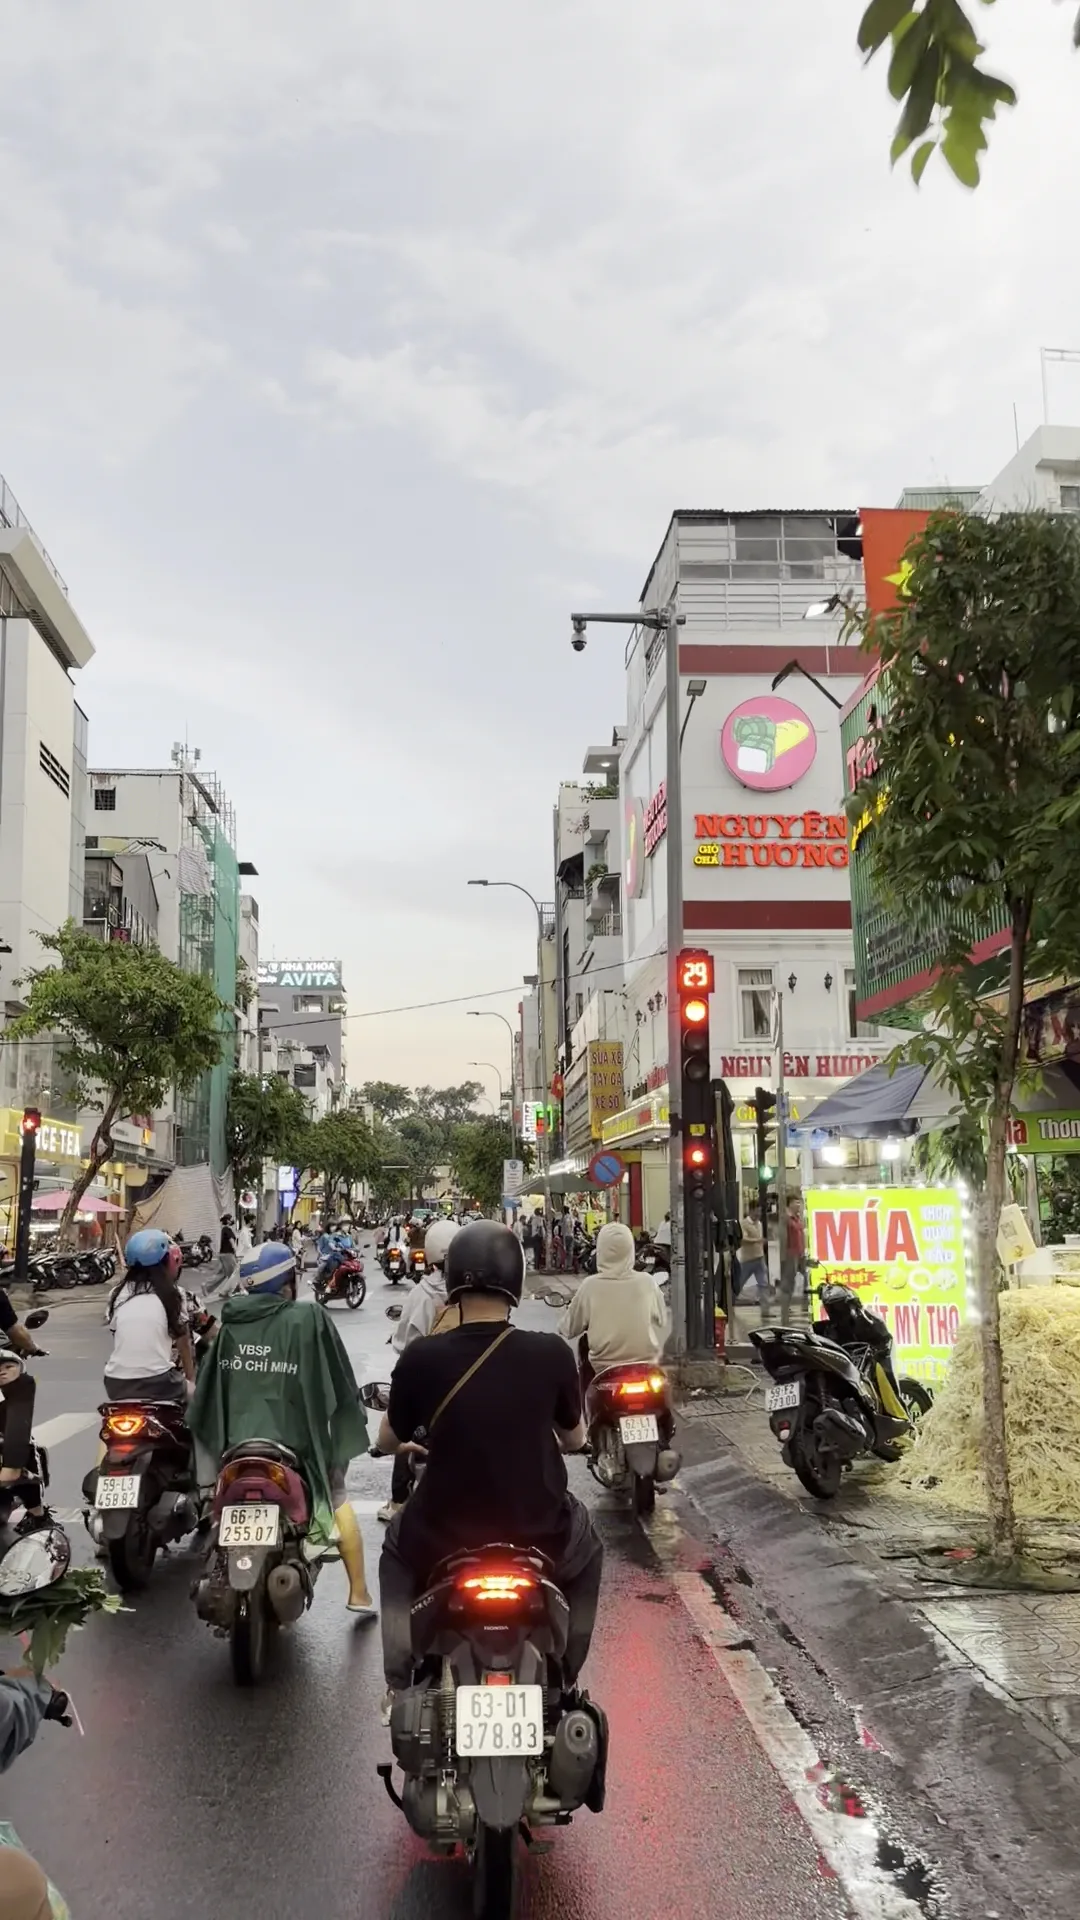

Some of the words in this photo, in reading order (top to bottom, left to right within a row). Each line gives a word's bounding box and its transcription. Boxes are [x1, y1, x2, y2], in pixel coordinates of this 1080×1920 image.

[694, 810, 848, 839] NGUYÊN
[721, 842, 848, 868] HƯƠNG
[280, 972, 338, 986] AVITA
[281, 962, 303, 972] NHA
[683, 962, 707, 987] 29
[60, 1129, 80, 1156] TEA
[815, 1200, 919, 1262] MÍA
[894, 1297, 920, 1345] MỸ
[239, 1344, 272, 1356] VBSP
[245, 1358, 268, 1372] CHÍ
[270, 1361, 298, 1375] MINH
[102, 1477, 134, 1492] 59-L3
[471, 1691, 527, 1719] 63-D1
[463, 1722, 538, 1750] 378.83
